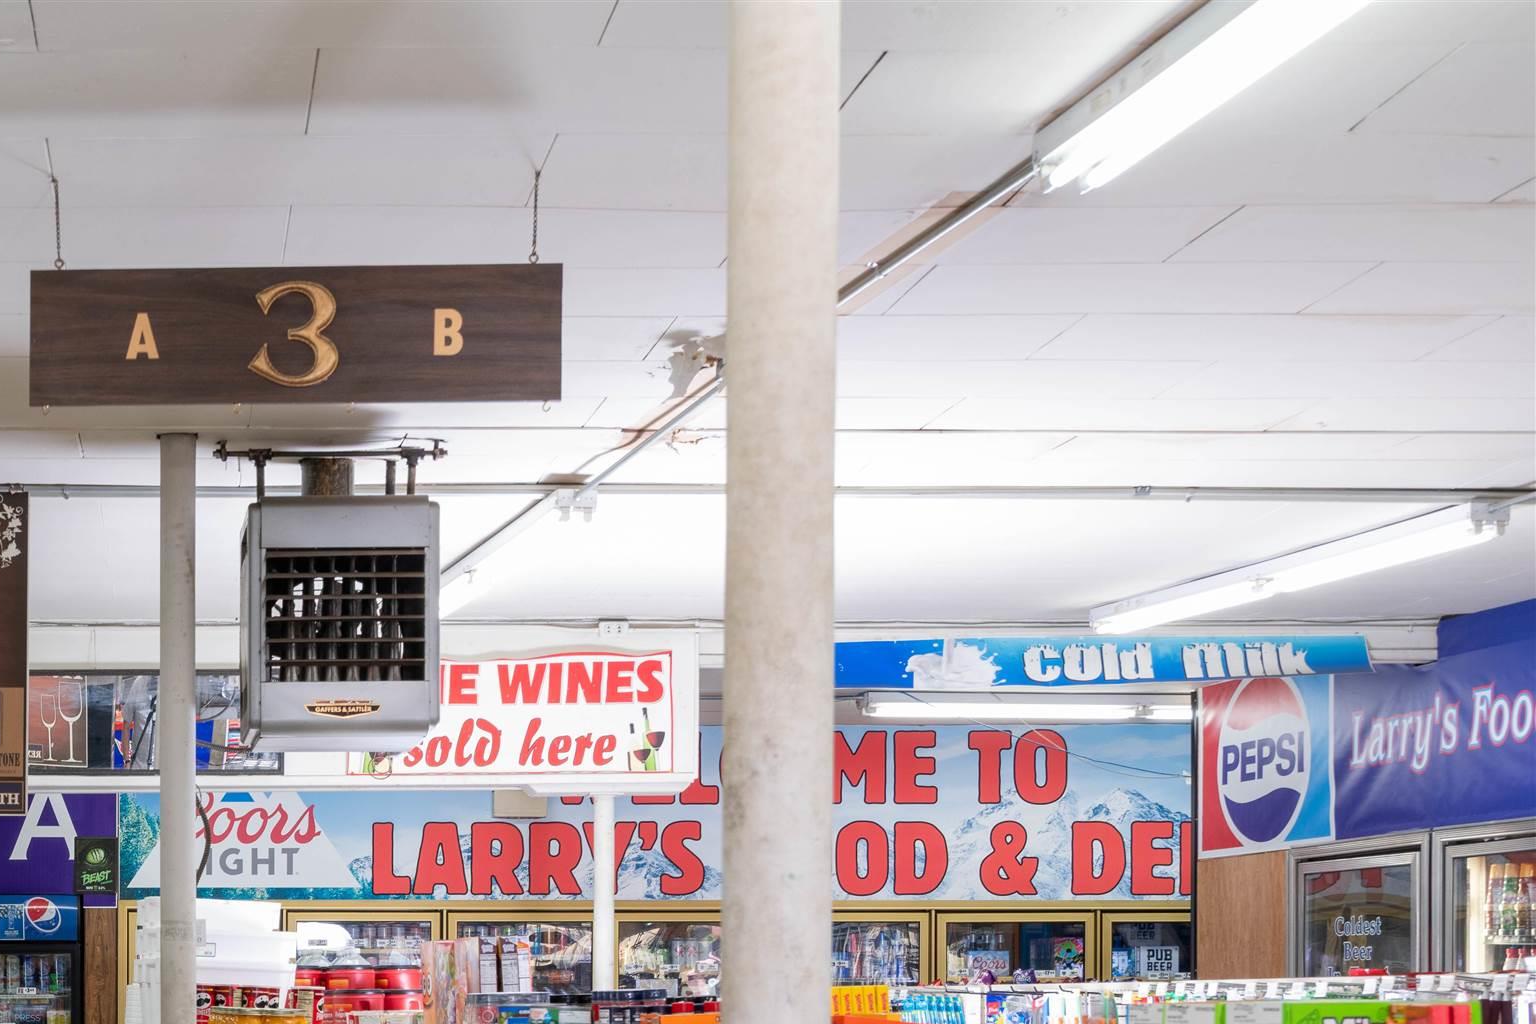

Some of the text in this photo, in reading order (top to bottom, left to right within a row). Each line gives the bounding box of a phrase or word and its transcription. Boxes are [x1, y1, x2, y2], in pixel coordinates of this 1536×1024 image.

[125, 280, 464, 388] A 3 B
[1023, 640, 1316, 682] cold milk
[440, 660, 664, 705] E WINES
[518, 717, 617, 767] here
[1350, 690, 1459, 774] Larry's
[967, 729, 1068, 805] TO
[1221, 731, 1305, 785] PEPSI
[205, 848, 300, 875] IGHT
[834, 820, 950, 896] OD
[979, 820, 1039, 896] &
[81, 870, 112, 886] BEAST
[1334, 915, 1382, 937] Coldest
[973, 957, 1006, 970] Coors
[1147, 949, 1172, 961] PUB
[1147, 962, 1172, 971] BEER
[1343, 941, 1373, 961] Beer
[15, 1013, 42, 1022] PRESS
